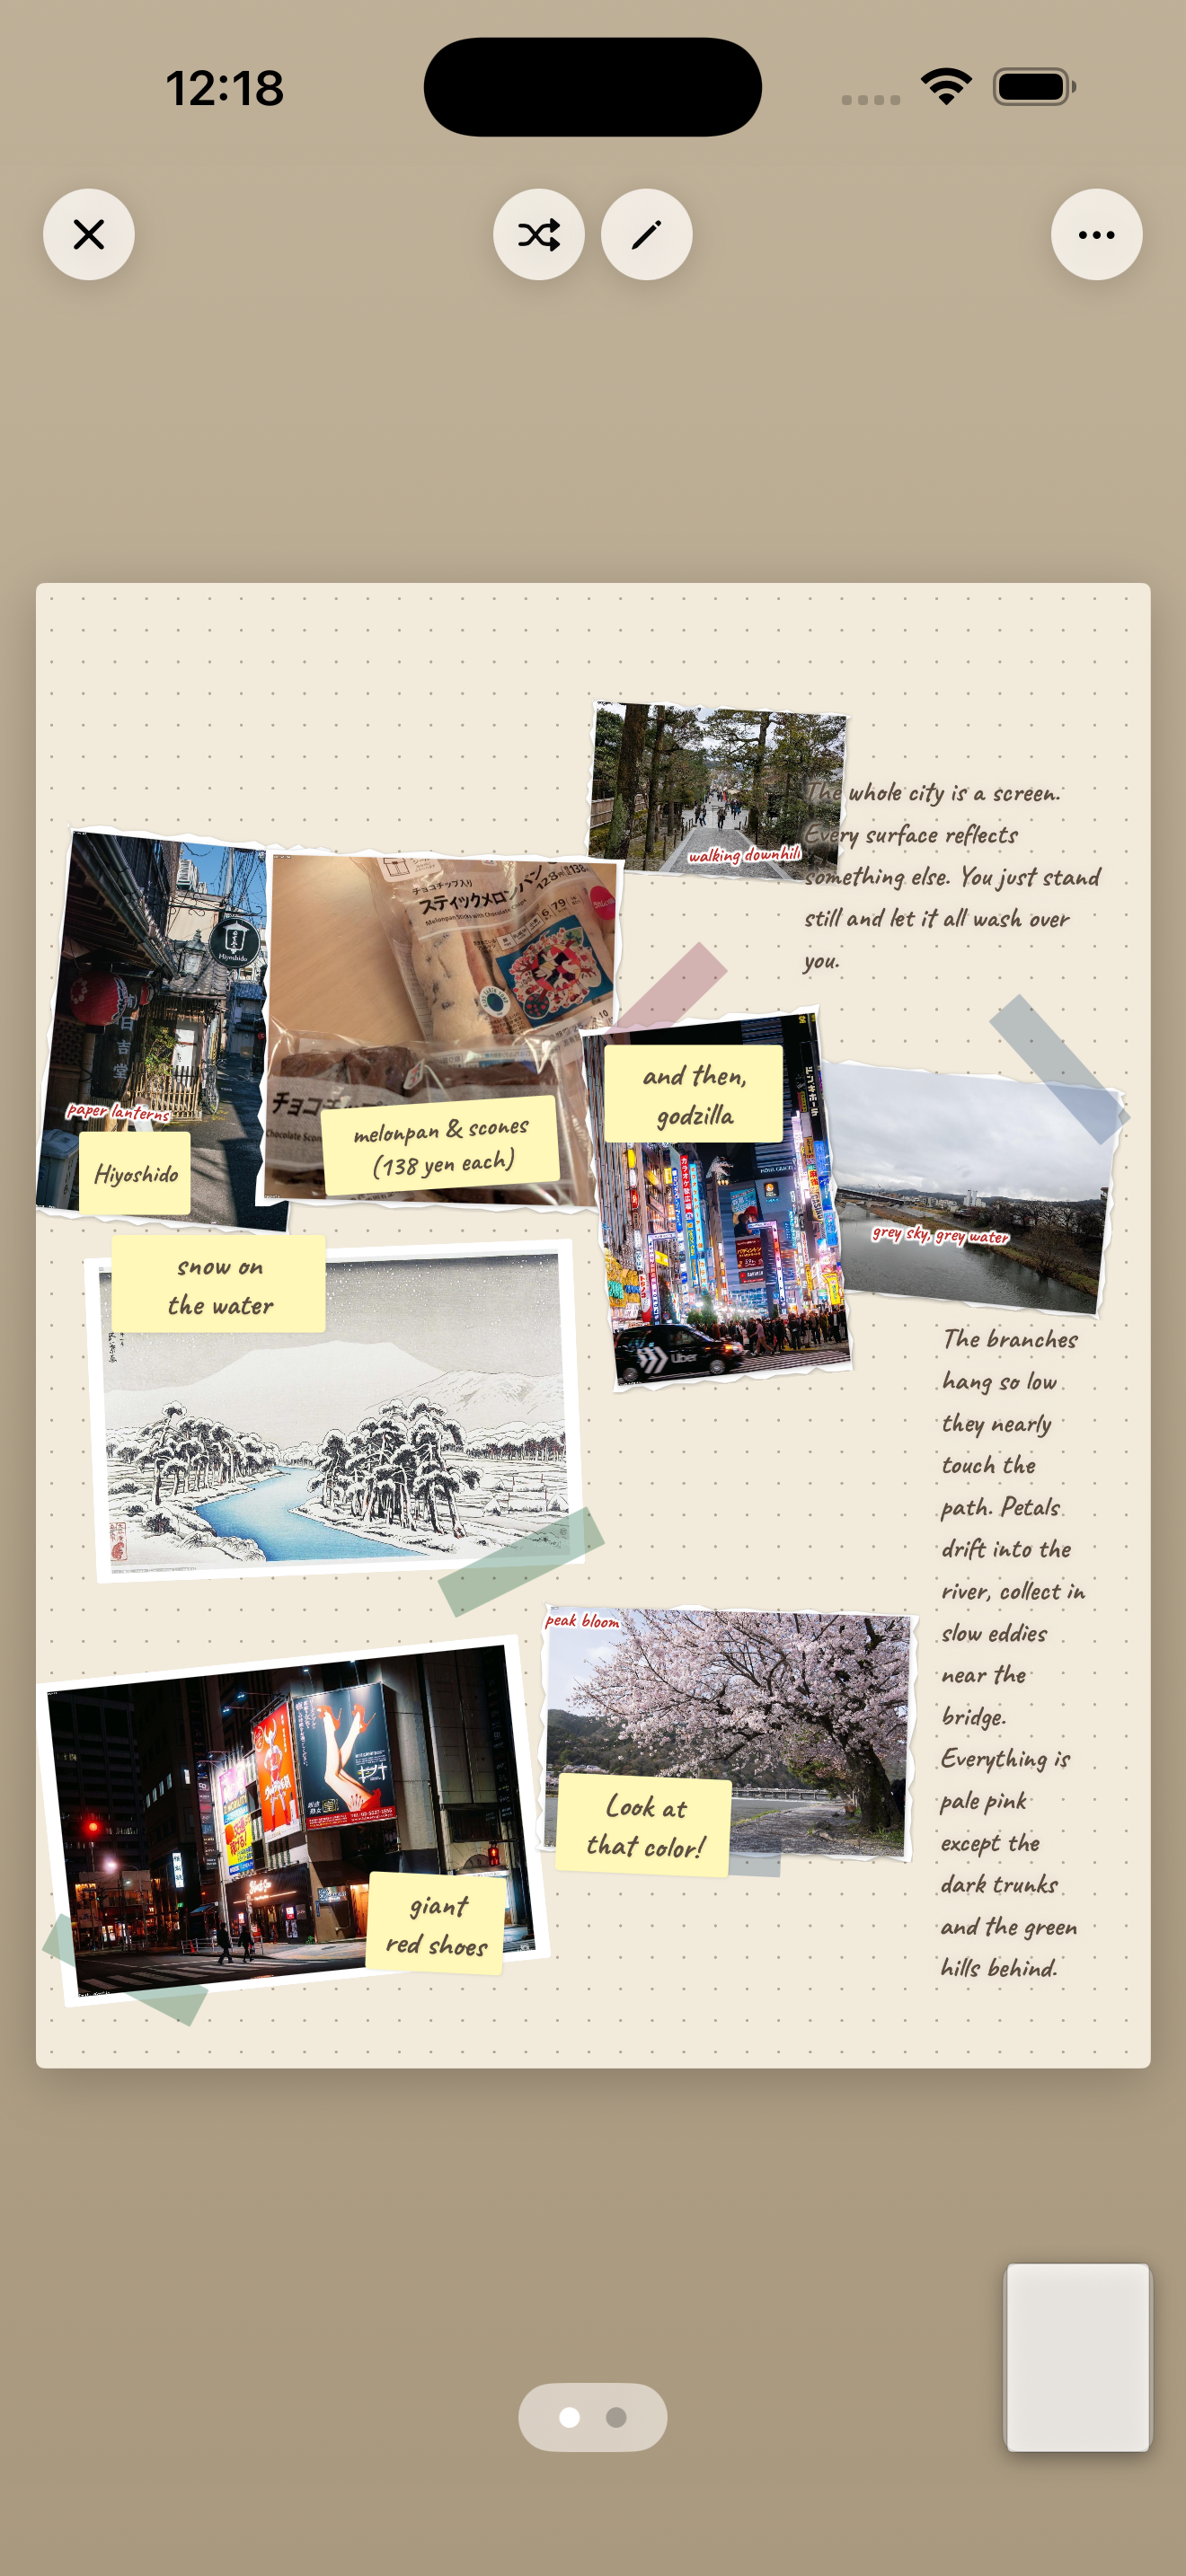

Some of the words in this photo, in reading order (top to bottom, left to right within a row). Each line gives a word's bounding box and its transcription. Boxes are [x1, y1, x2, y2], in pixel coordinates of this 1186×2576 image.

[166, 69, 284, 107] 12:18
[412, 879, 473, 896] チョコチップ入り
[419, 865, 543, 915] スティックメロンパン
[425, 914, 456, 927] Melonpan
[456, 913, 472, 921] Sticks
[485, 906, 511, 918] Chocolate
[511, 898, 527, 910] Chips
[218, 952, 248, 962] Hiyoshido
[266, 1129, 301, 1142] Chocolate
[303, 1132, 323, 1142] Scon
[810, 1170, 819, 1186] 麻雀
[811, 1194, 824, 1220] CASINO
[671, 1353, 698, 1363] Uber
